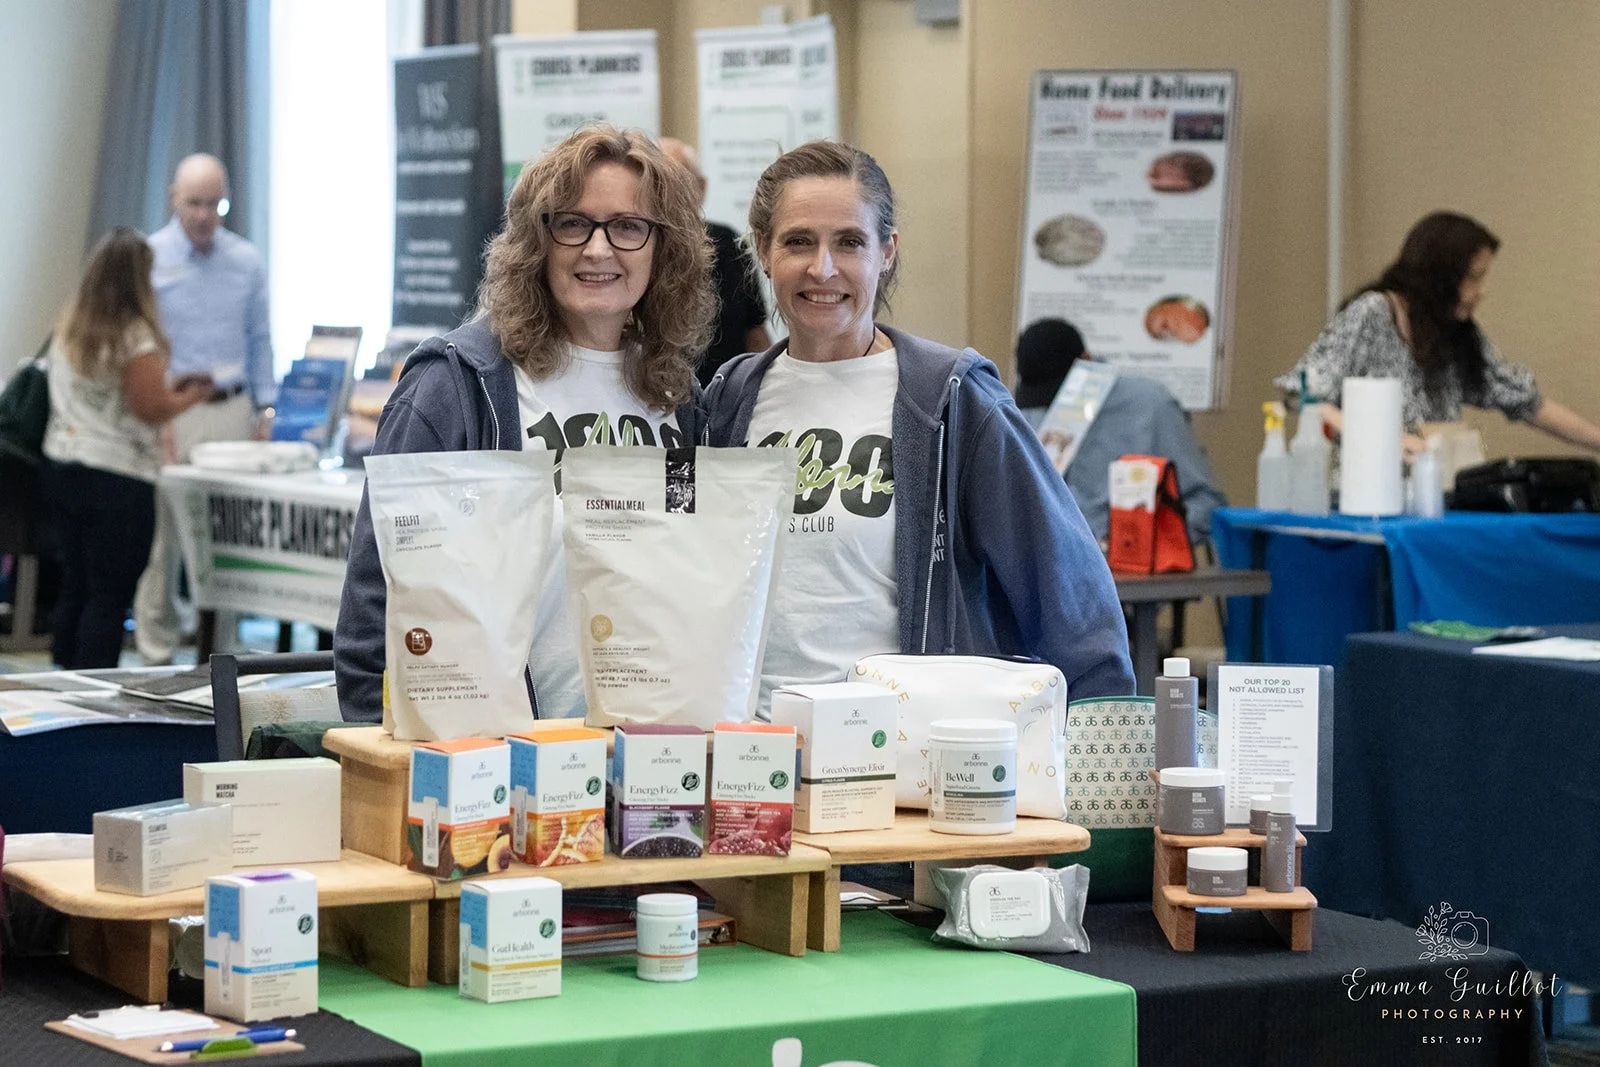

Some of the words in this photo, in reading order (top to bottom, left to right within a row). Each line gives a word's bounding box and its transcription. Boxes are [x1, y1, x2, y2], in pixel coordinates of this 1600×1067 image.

[1151, 76, 1226, 104] Delivery
[586, 500, 646, 511] ESSENTIALMEAL
[395, 514, 420, 527] FEELFIT
[802, 516, 834, 532] CLUB
[651, 756, 682, 764] arbonne
[738, 754, 770, 762] arbonne
[561, 762, 586, 771] arbonne
[822, 766, 867, 775] GreenSynergy
[868, 764, 885, 772] Elixir
[946, 773, 975, 782] BeWell
[216, 782, 238, 790] MORNING
[630, 784, 678, 796] EnergyFizz
[717, 780, 766, 792] EnergyFizz
[543, 791, 584, 803] EnergyFizz
[455, 800, 491, 813] EnergyFizz
[512, 909, 540, 918] arbonne
[251, 946, 272, 957] Sport
[492, 942, 534, 953] GutHealth
